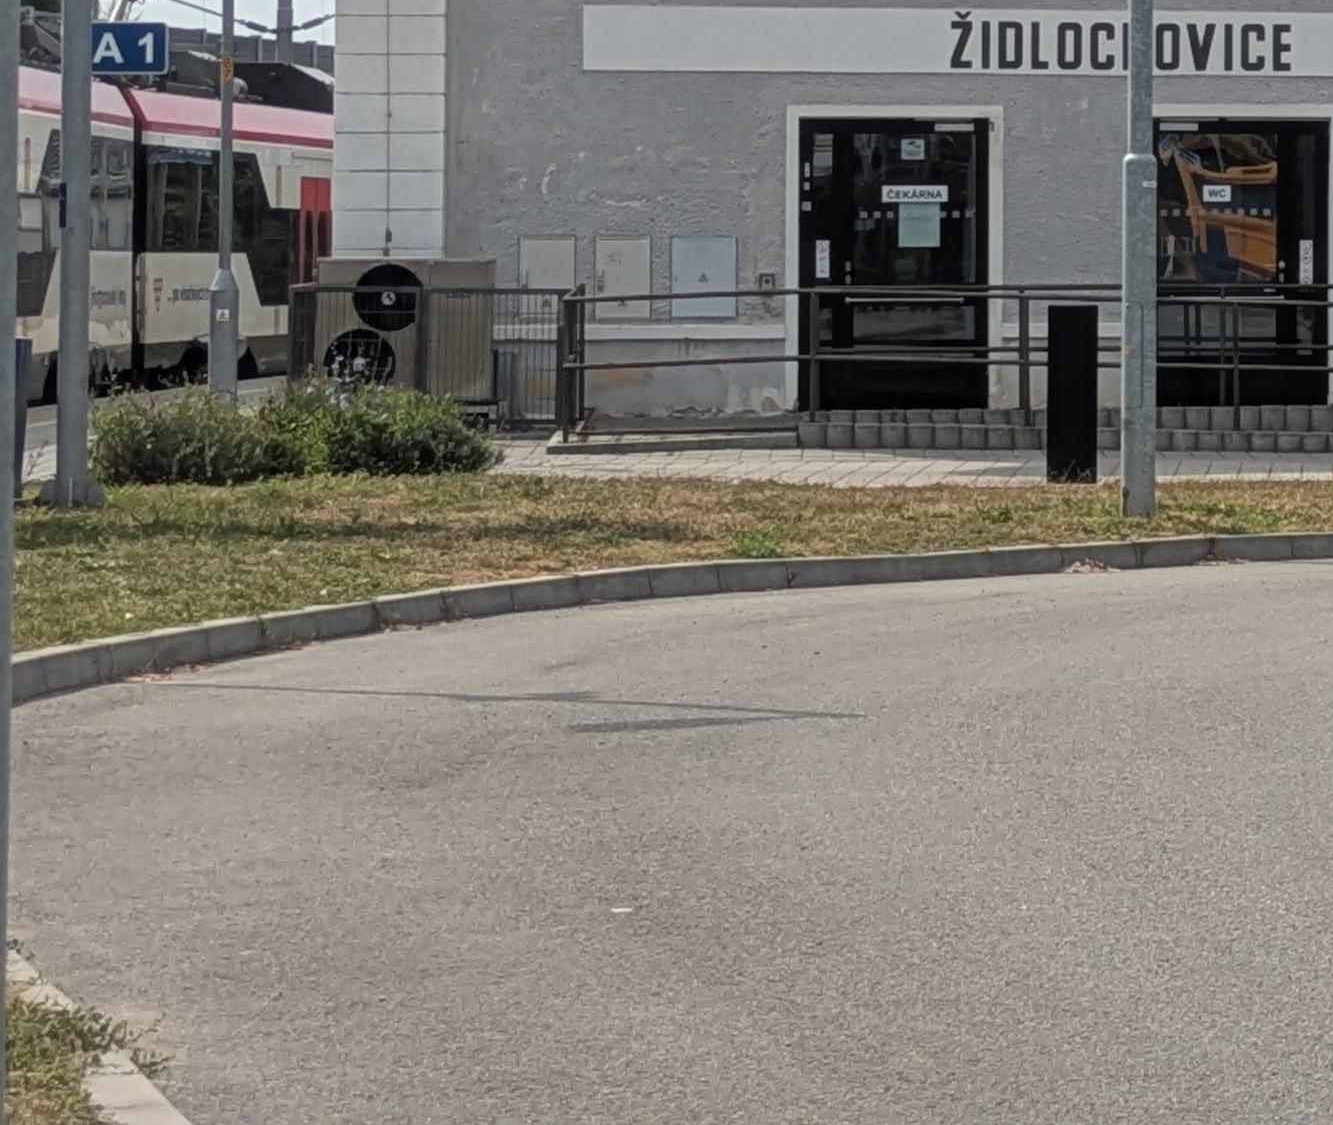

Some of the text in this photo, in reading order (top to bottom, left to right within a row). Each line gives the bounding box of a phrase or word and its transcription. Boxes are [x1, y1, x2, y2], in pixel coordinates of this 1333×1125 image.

[93, 32, 154, 64] A 1
[950, 11, 1291, 72] ŽIDLOCOVICE
[886, 188, 943, 200] ČEKÁRNA
[1208, 189, 1227, 198] WC
